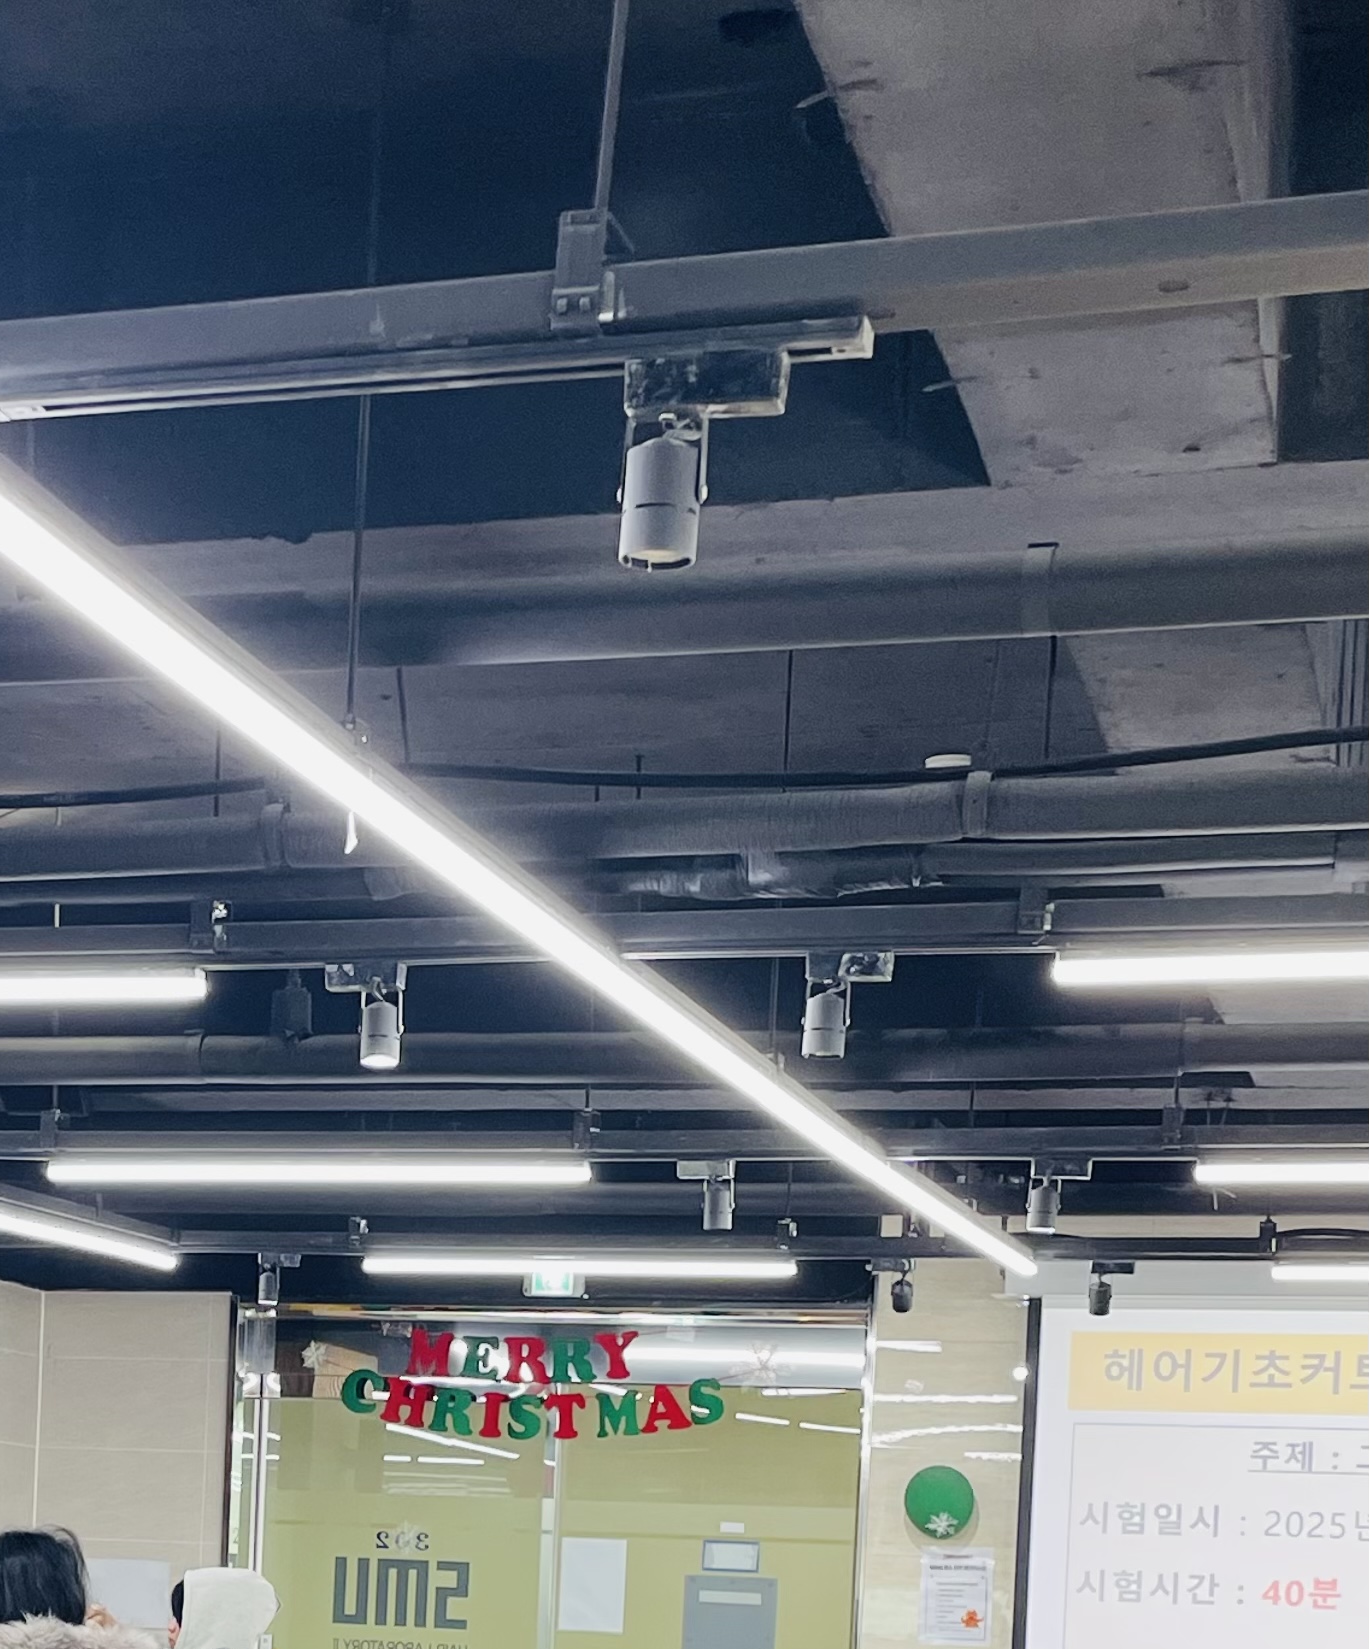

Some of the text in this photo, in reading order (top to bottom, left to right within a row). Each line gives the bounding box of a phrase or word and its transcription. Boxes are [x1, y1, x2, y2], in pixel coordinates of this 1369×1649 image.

[406, 1327, 639, 1384] MERRY
[341, 1369, 725, 1440] CHRISTMAS
[1249, 1441, 1314, 1472] 주제
[1079, 1501, 1220, 1538] 시험일시
[1076, 1569, 1220, 1606] 시험시간
[1261, 1577, 1342, 1610] 40분
